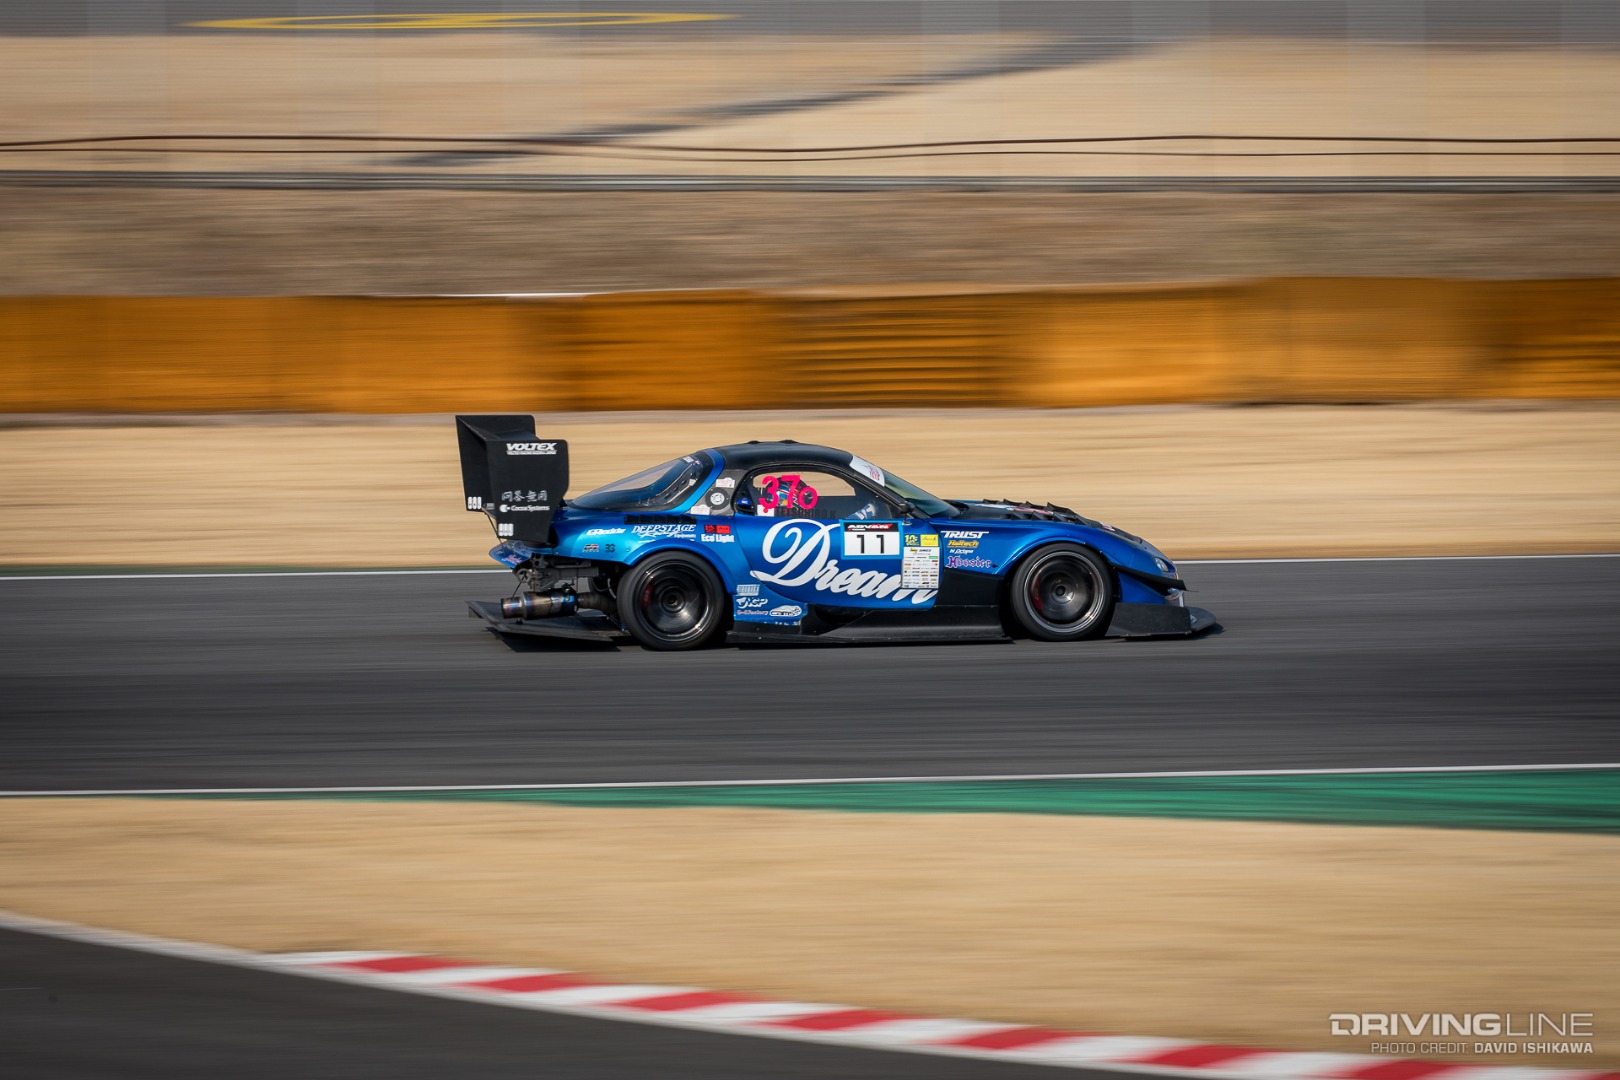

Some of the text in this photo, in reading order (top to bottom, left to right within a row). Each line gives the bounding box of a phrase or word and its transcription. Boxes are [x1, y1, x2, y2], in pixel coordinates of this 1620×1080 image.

[506, 442, 557, 451] VOLTEX
[631, 524, 697, 534] DEEPSTAGE
[940, 530, 990, 539] TRUST
[857, 534, 885, 554] 11
[750, 518, 938, 605] Dream
[945, 555, 992, 569] Hoosier
